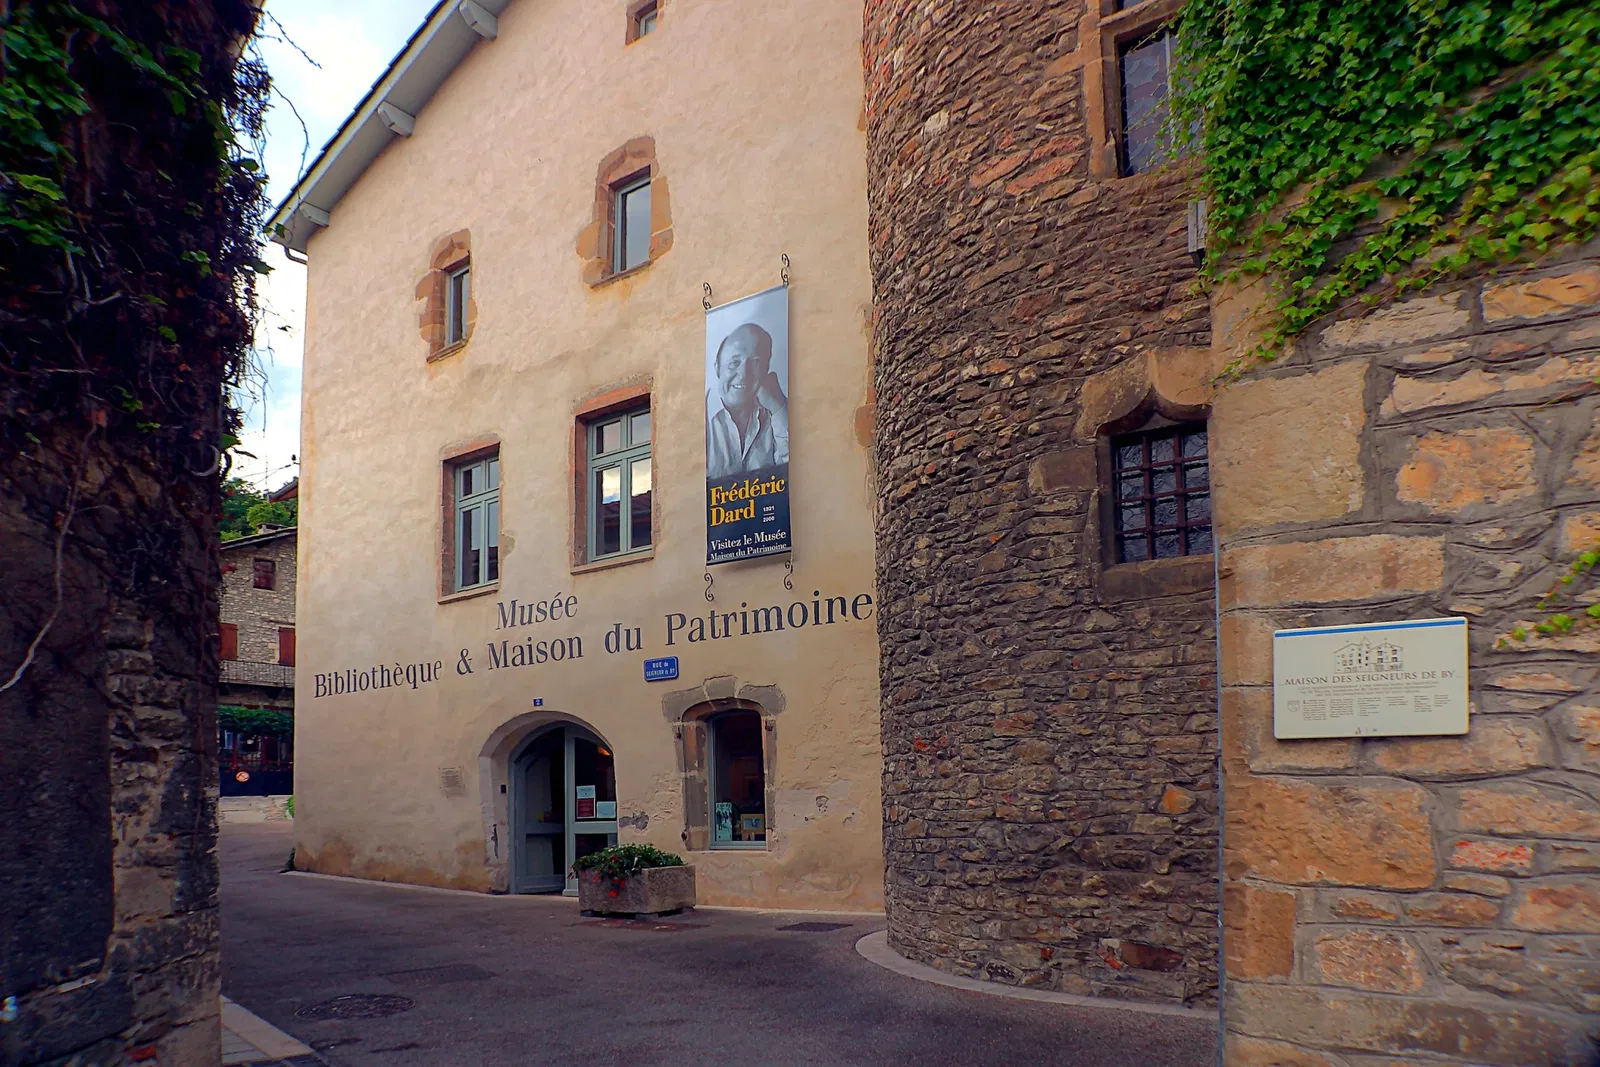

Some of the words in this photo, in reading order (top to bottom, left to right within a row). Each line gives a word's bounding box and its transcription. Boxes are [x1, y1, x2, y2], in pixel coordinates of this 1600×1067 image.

[710, 475, 785, 506] Frédéric
[710, 499, 755, 526] Dard
[711, 538, 741, 551] Visitez
[743, 535, 752, 545] le
[754, 529, 786, 543] Musée
[711, 552, 735, 561] Maison
[735, 549, 746, 557] du
[747, 543, 787, 555] Patrimoine
[495, 592, 578, 630] Musée
[314, 659, 443, 698] Bibliothèque
[456, 648, 474, 675] &
[487, 634, 584, 670] Maison
[604, 623, 643, 654] du
[665, 590, 873, 646] Patrimoine
[1285, 676, 1328, 685] MAISON
[1332, 675, 1352, 683] DES
[1355, 672, 1417, 682] SEIGNEURS
[1421, 671, 1437, 679] DE
[1441, 670, 1455, 678] BY
